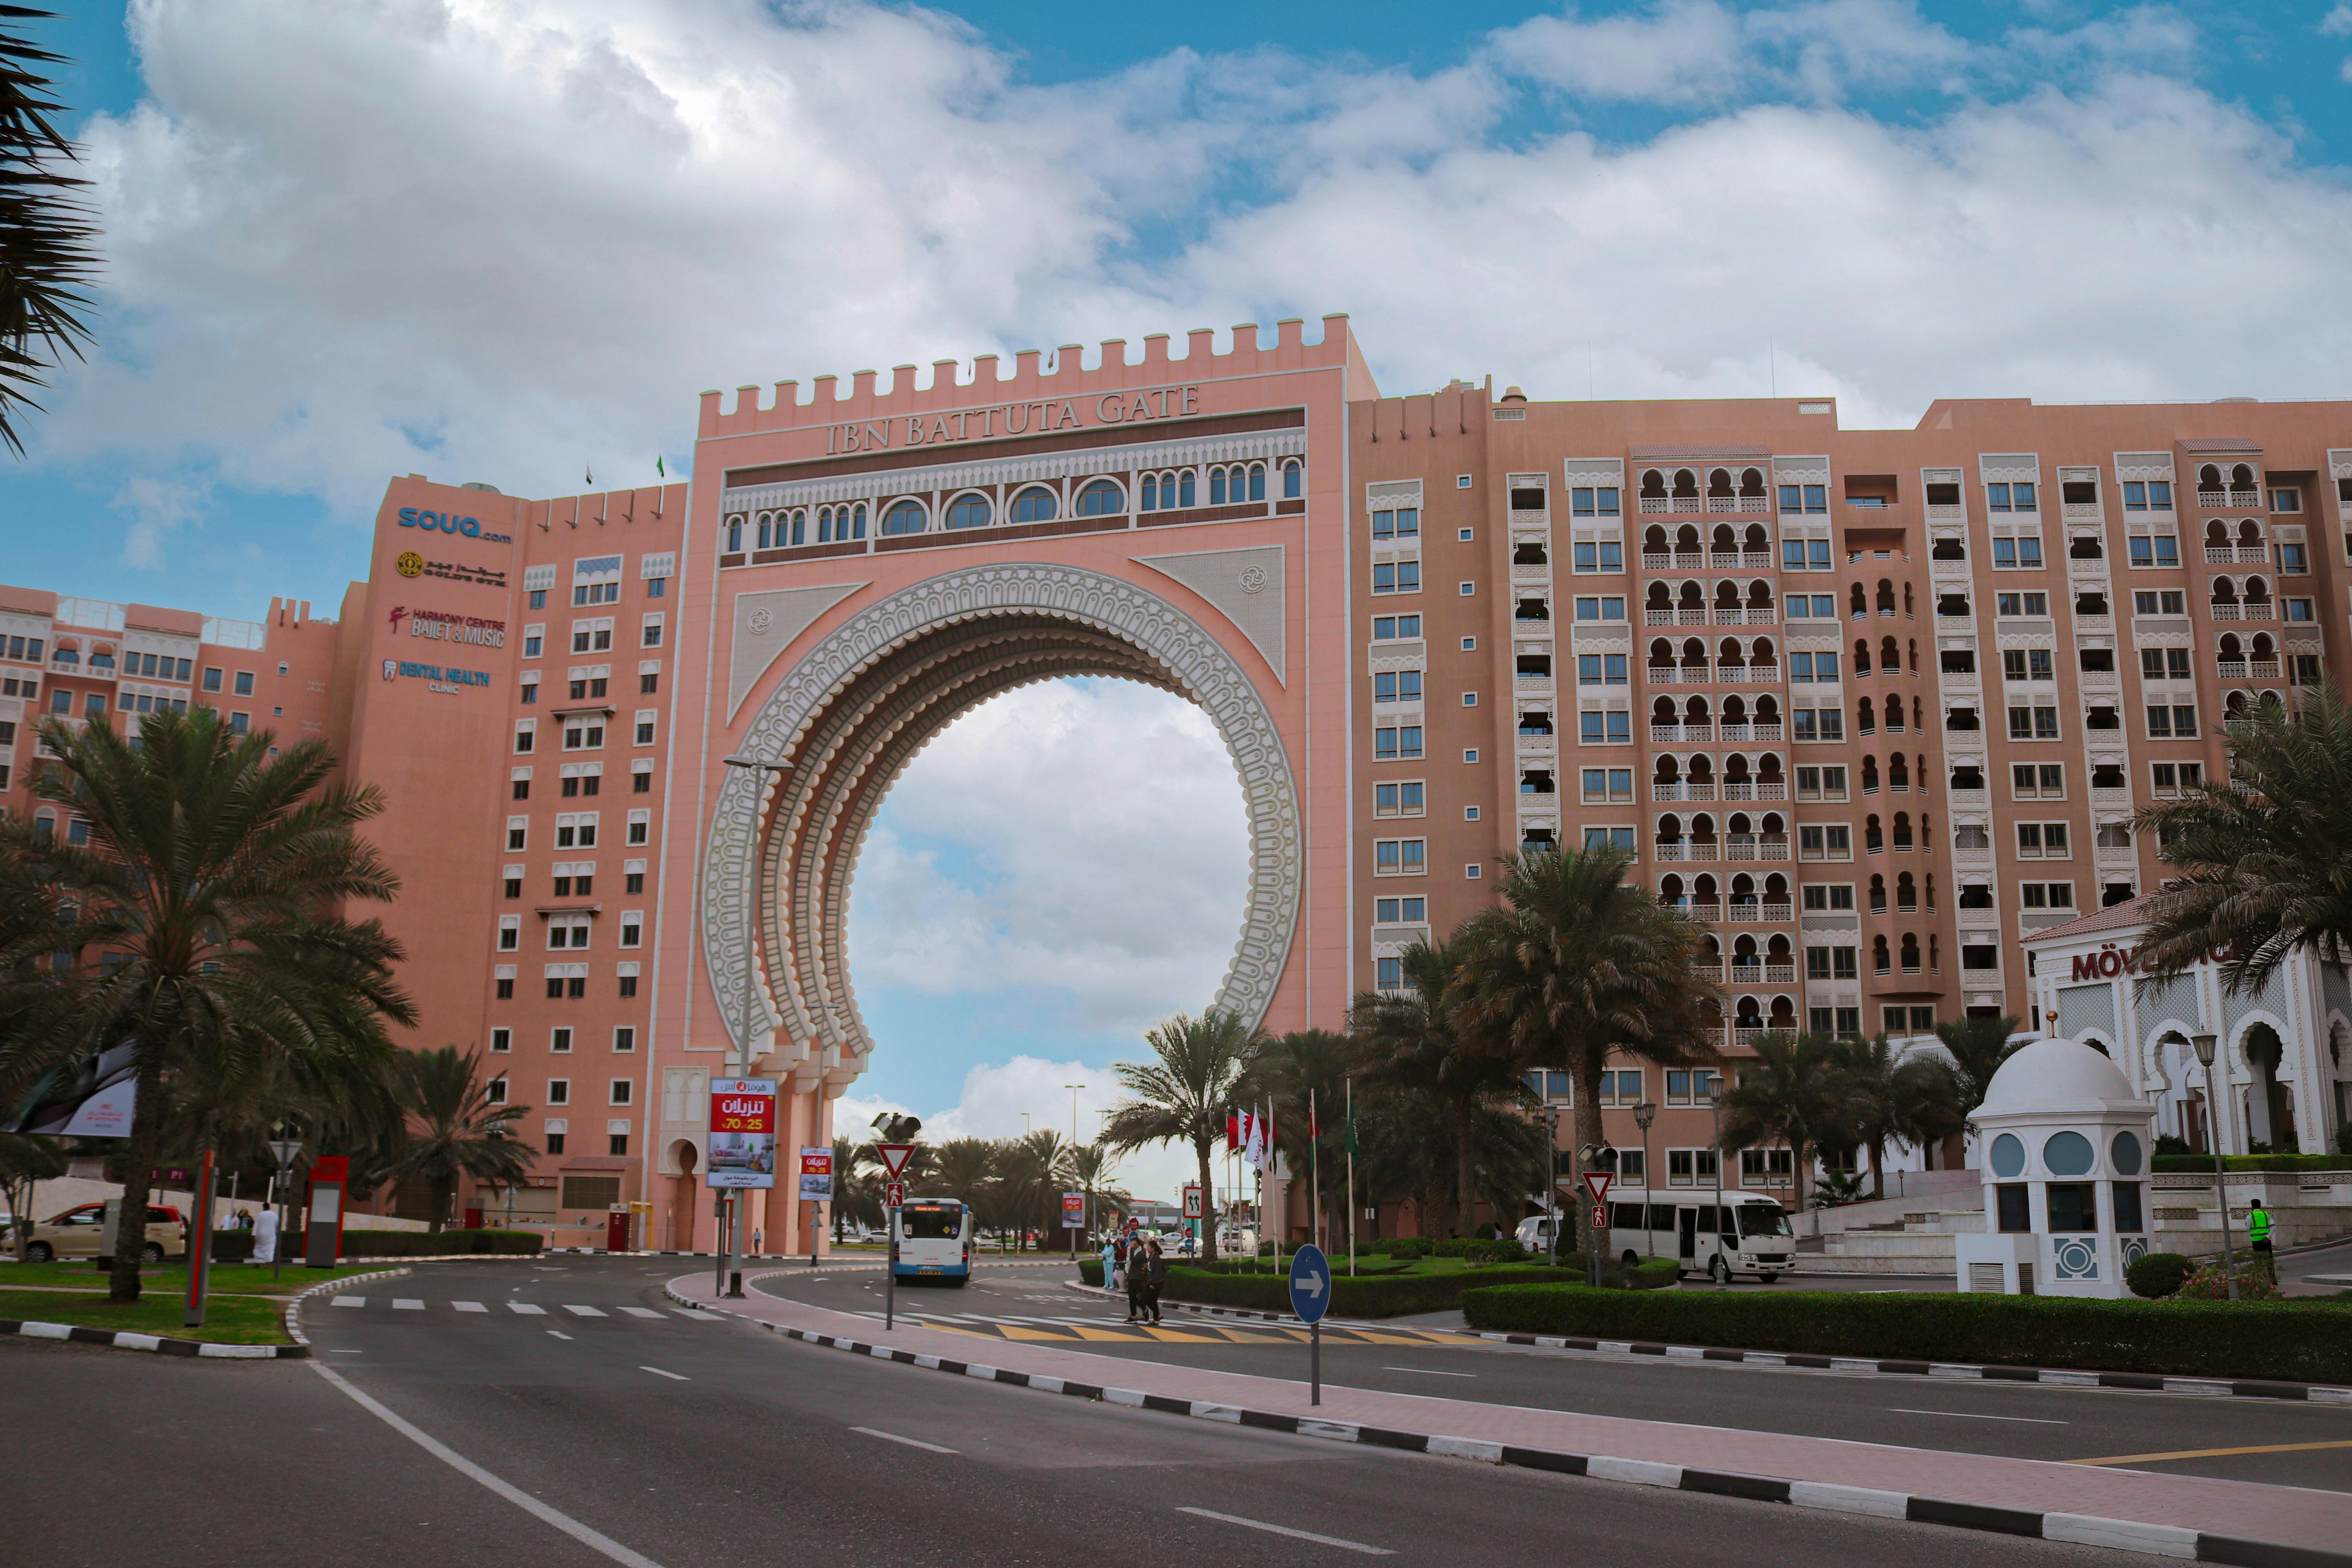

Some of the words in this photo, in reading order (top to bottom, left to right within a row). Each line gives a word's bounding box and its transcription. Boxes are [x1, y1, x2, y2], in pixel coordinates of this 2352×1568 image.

[826, 420, 892, 455] IBN
[905, 399, 1083, 446] BATTUTA
[1096, 385, 1199, 423] GATE
[398, 507, 511, 544] SOUQ.com
[424, 569, 472, 582] GOLD'S
[475, 577, 506, 587] GYM
[412, 618, 452, 641] BALLET
[452, 628, 461, 642] &
[413, 609, 465, 625] HARMONY
[466, 617, 505, 632] CENTRE
[399, 661, 443, 681] DENTAL
[445, 668, 490, 687] HEALTH
[429, 682, 460, 695] CLINIC
[747, 1083, 766, 1093] هومز
[722, 1098, 764, 1117] تنزيلات
[747, 1119, 763, 1130] 25
